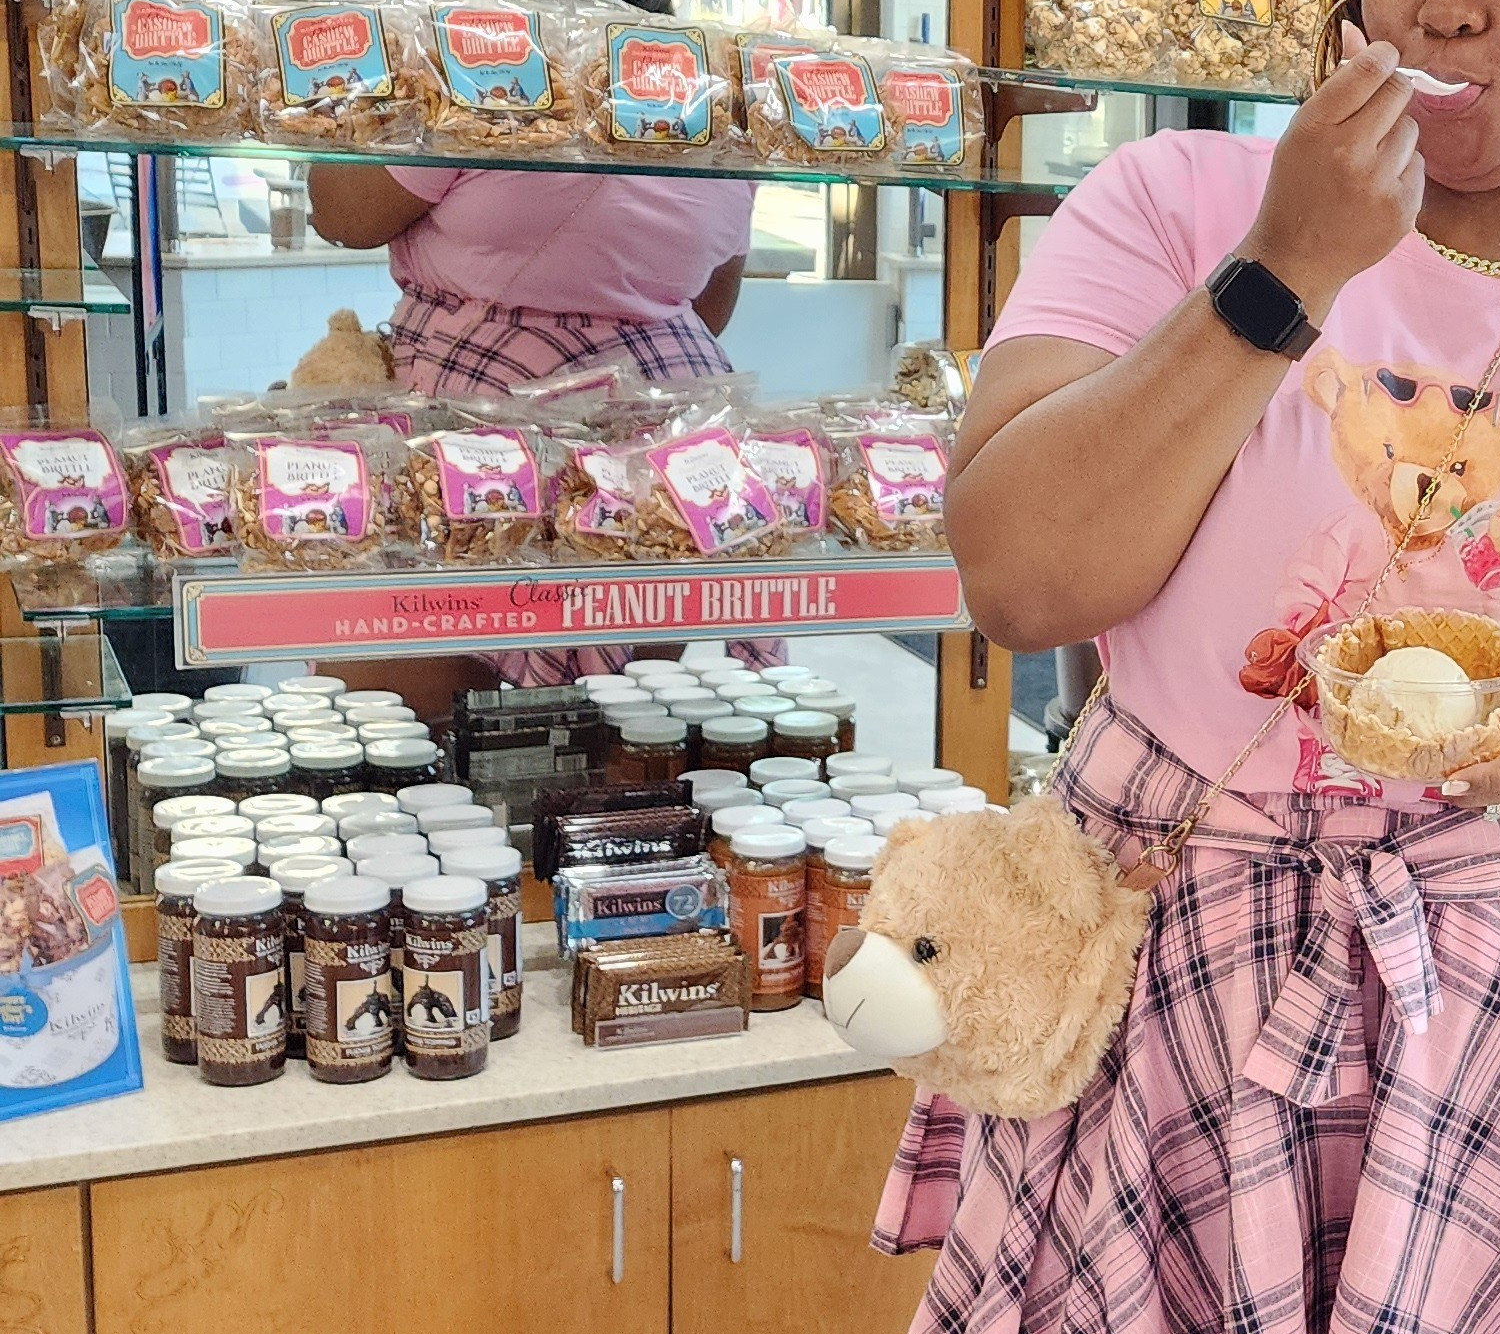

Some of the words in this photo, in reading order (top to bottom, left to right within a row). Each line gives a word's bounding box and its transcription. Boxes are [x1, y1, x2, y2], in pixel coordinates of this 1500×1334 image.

[303, 24, 355, 50] CASHEW
[335, 611, 537, 636] HAND-CRAFTED
[562, 583, 691, 627] PEANUT
[701, 577, 837, 622] BRITTLE
[392, 593, 484, 615] Kilwins
[508, 576, 590, 608] Classic
[596, 896, 662, 914] Kilwins
[406, 934, 453, 952] Kilwins
[617, 980, 720, 1008] Kilwins
